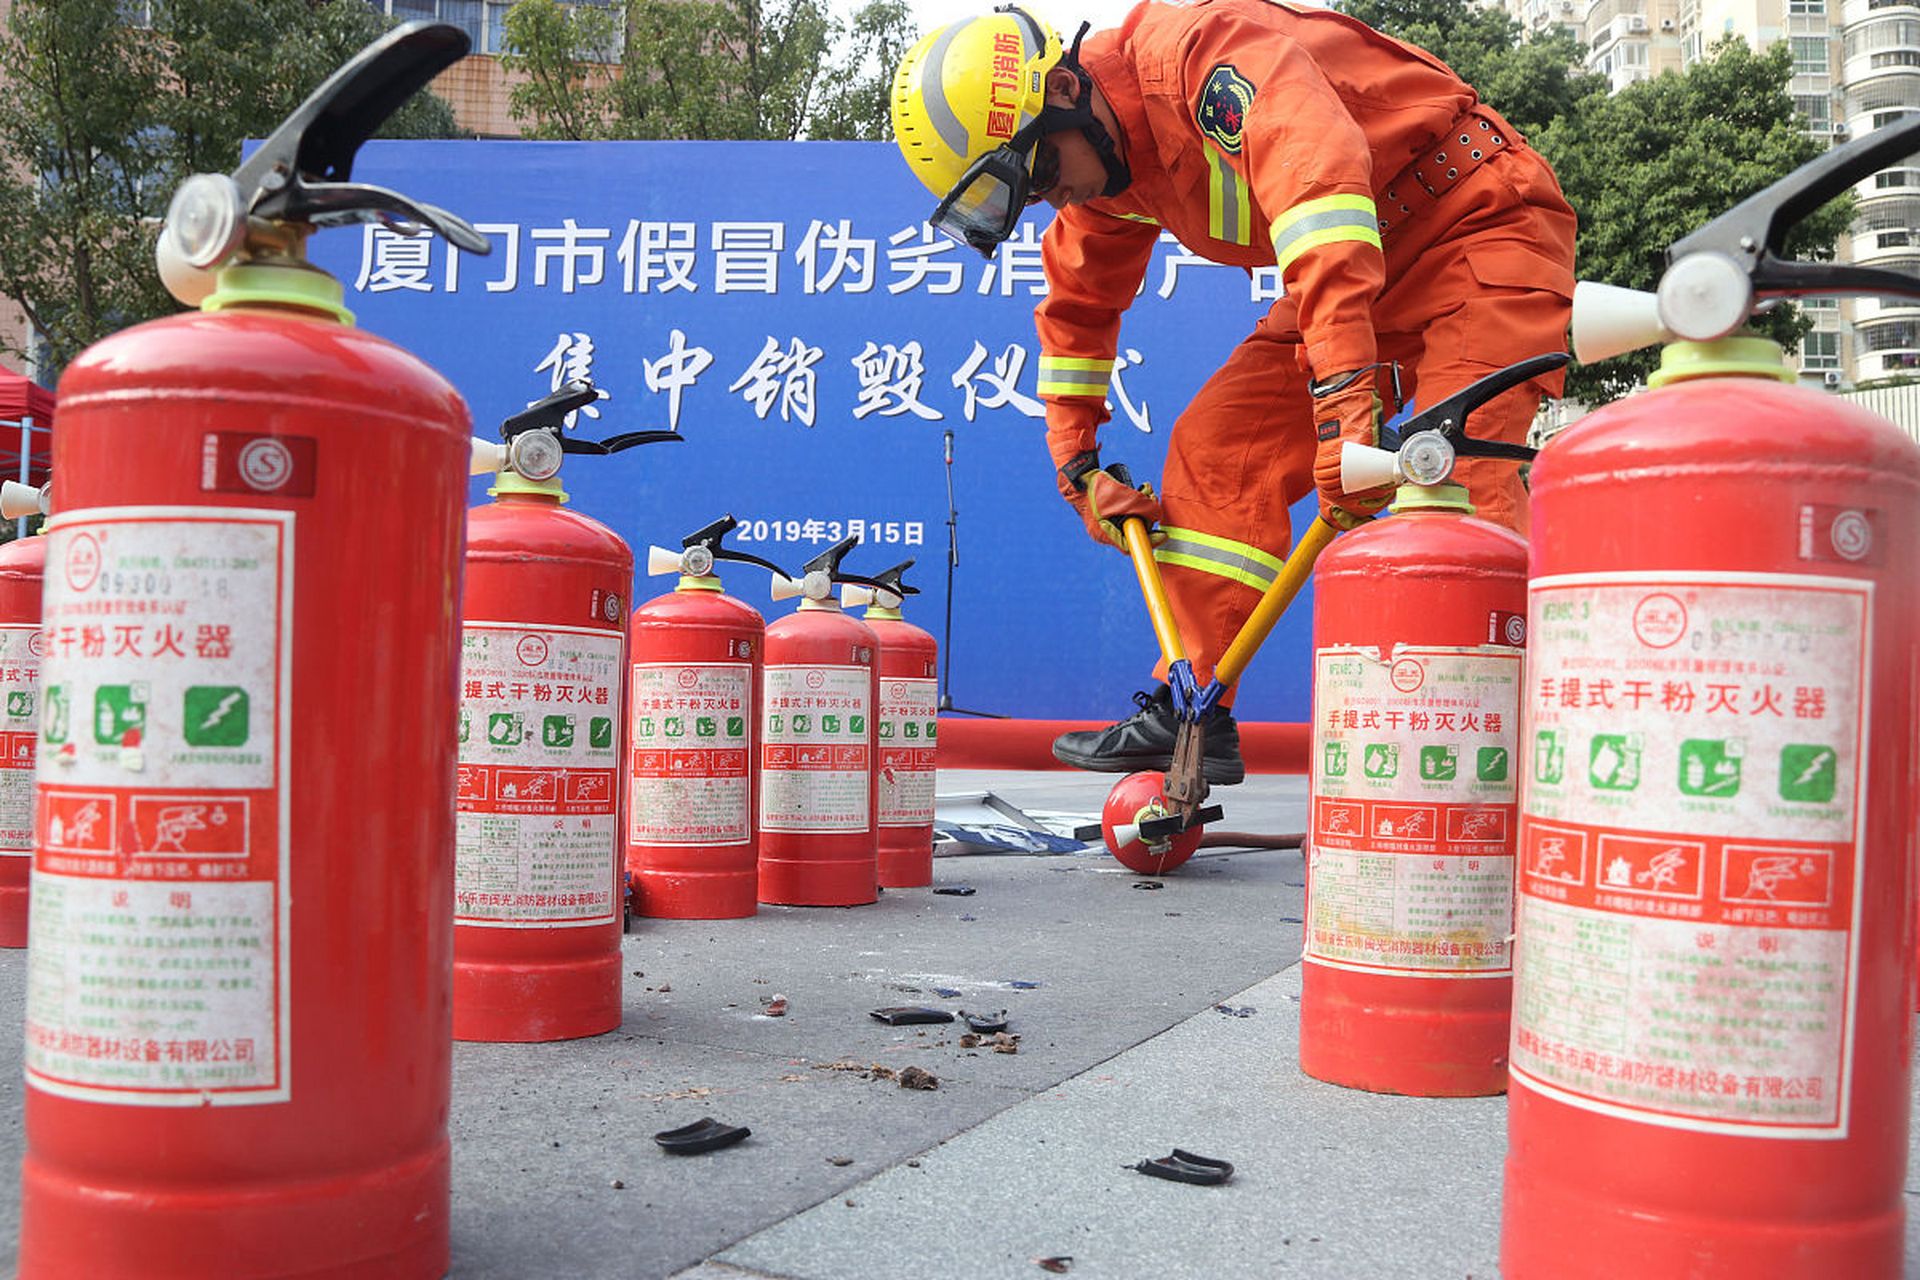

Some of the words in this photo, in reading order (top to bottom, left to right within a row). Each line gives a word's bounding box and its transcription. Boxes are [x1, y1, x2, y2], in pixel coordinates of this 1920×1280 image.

[986, 33, 1019, 140] 厦门消防
[355, 219, 1285, 302] 厦门市假冒伪劣消产
[737, 519, 923, 545] 2019年3月15日
[464, 680, 608, 705] 提式干粉灭火器
[1539, 678, 1826, 720] 手提式干粉灭火器
[1328, 709, 1502, 733] 手提式干粉灭火器
